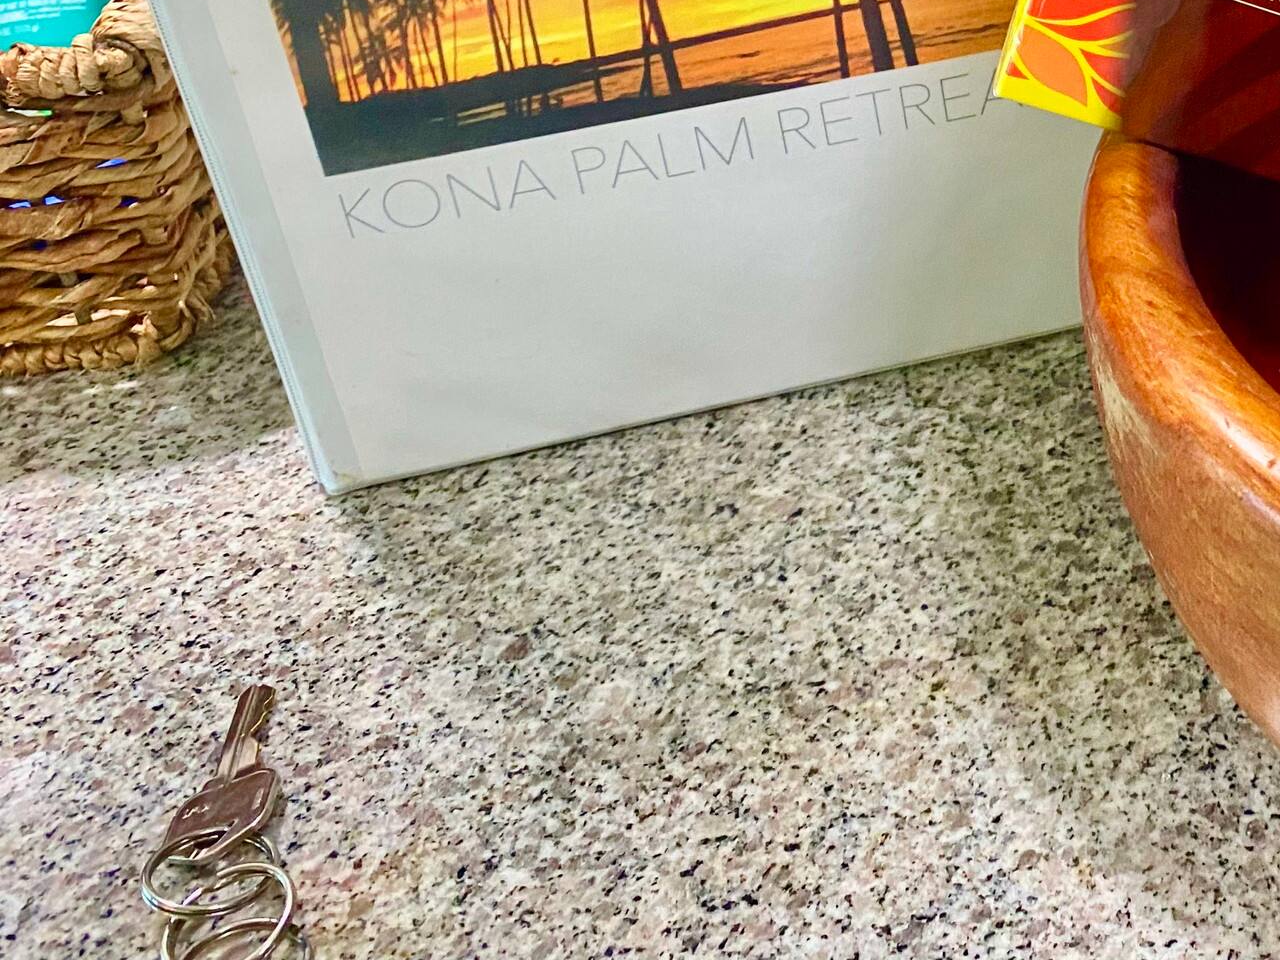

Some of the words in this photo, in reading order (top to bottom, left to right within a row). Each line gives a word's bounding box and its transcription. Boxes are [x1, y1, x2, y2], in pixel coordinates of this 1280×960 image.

[338, 159, 557, 239] KONA
[570, 116, 755, 195] PALM
[777, 67, 1004, 155] RETREA
